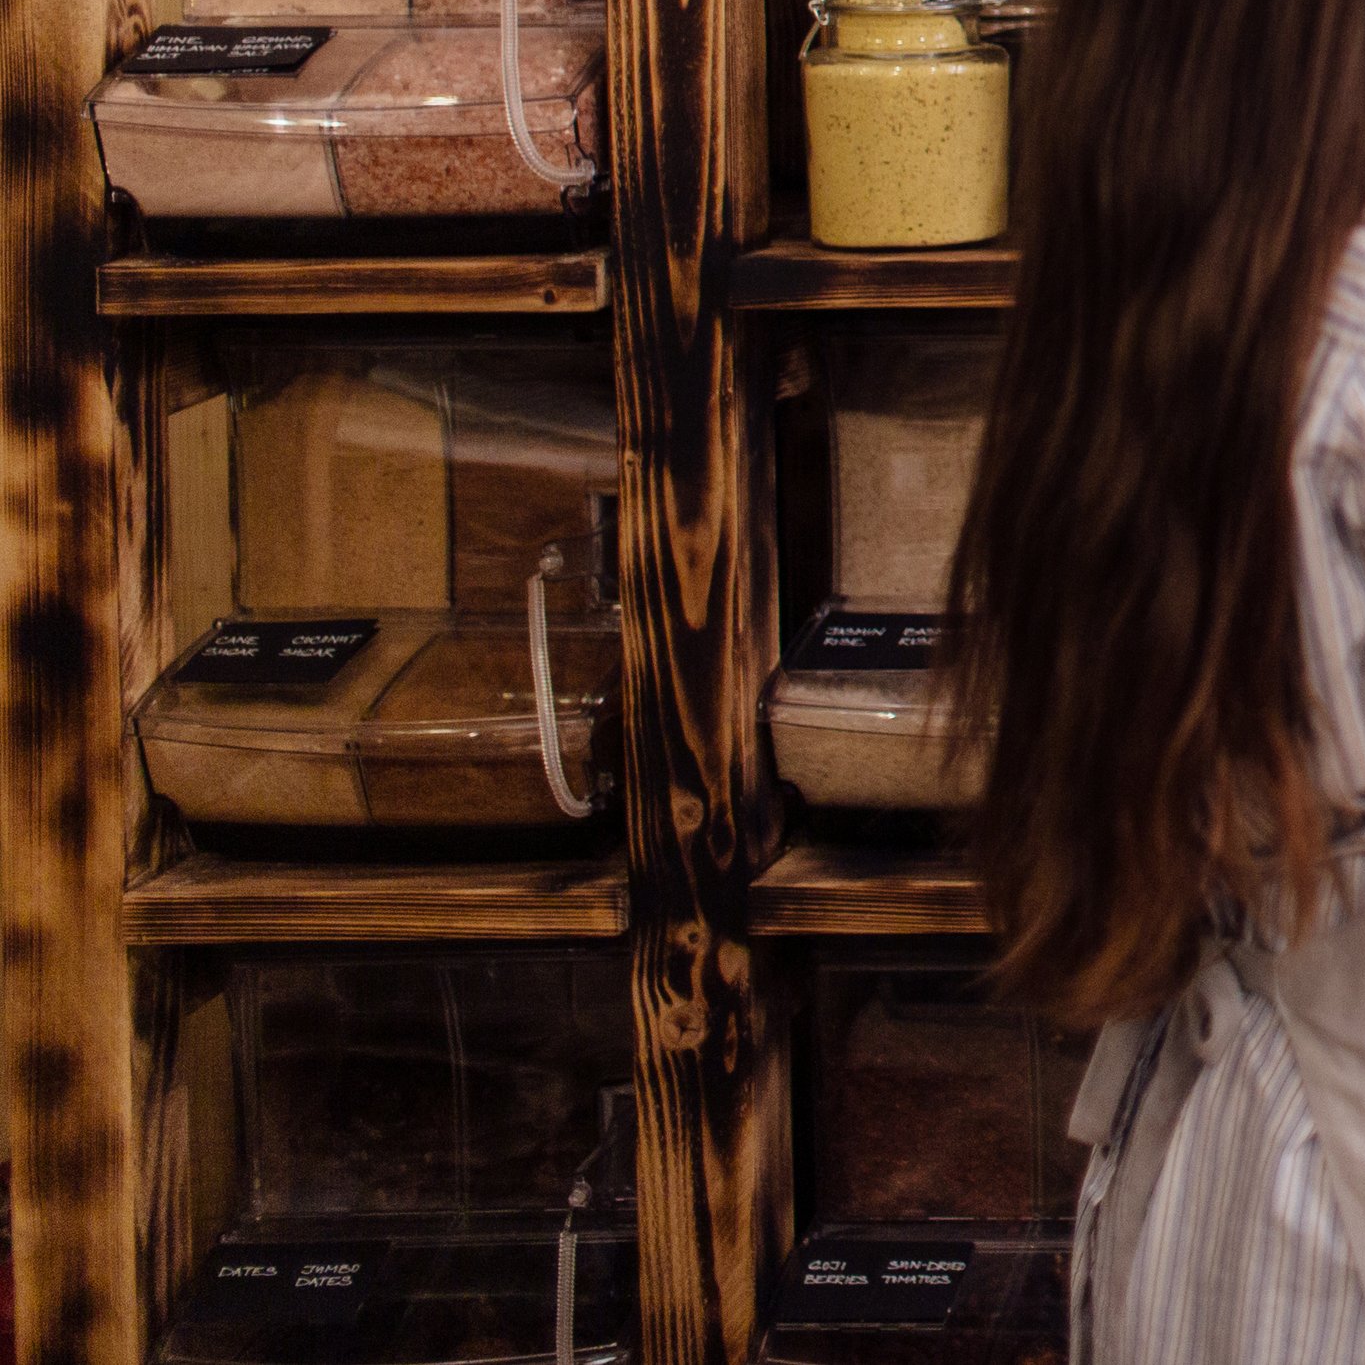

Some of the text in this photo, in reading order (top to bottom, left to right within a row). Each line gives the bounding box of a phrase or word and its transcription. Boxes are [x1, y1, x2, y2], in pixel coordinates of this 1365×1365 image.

[154, 36, 203, 45] FINE
[214, 635, 260, 645] CANE
[300, 1263, 361, 1276] JUMBO
[807, 1260, 847, 1271] GOJI
[217, 1266, 278, 1278] DATES
[294, 1275, 353, 1288] DATES
[803, 1274, 869, 1285] BERRIES
